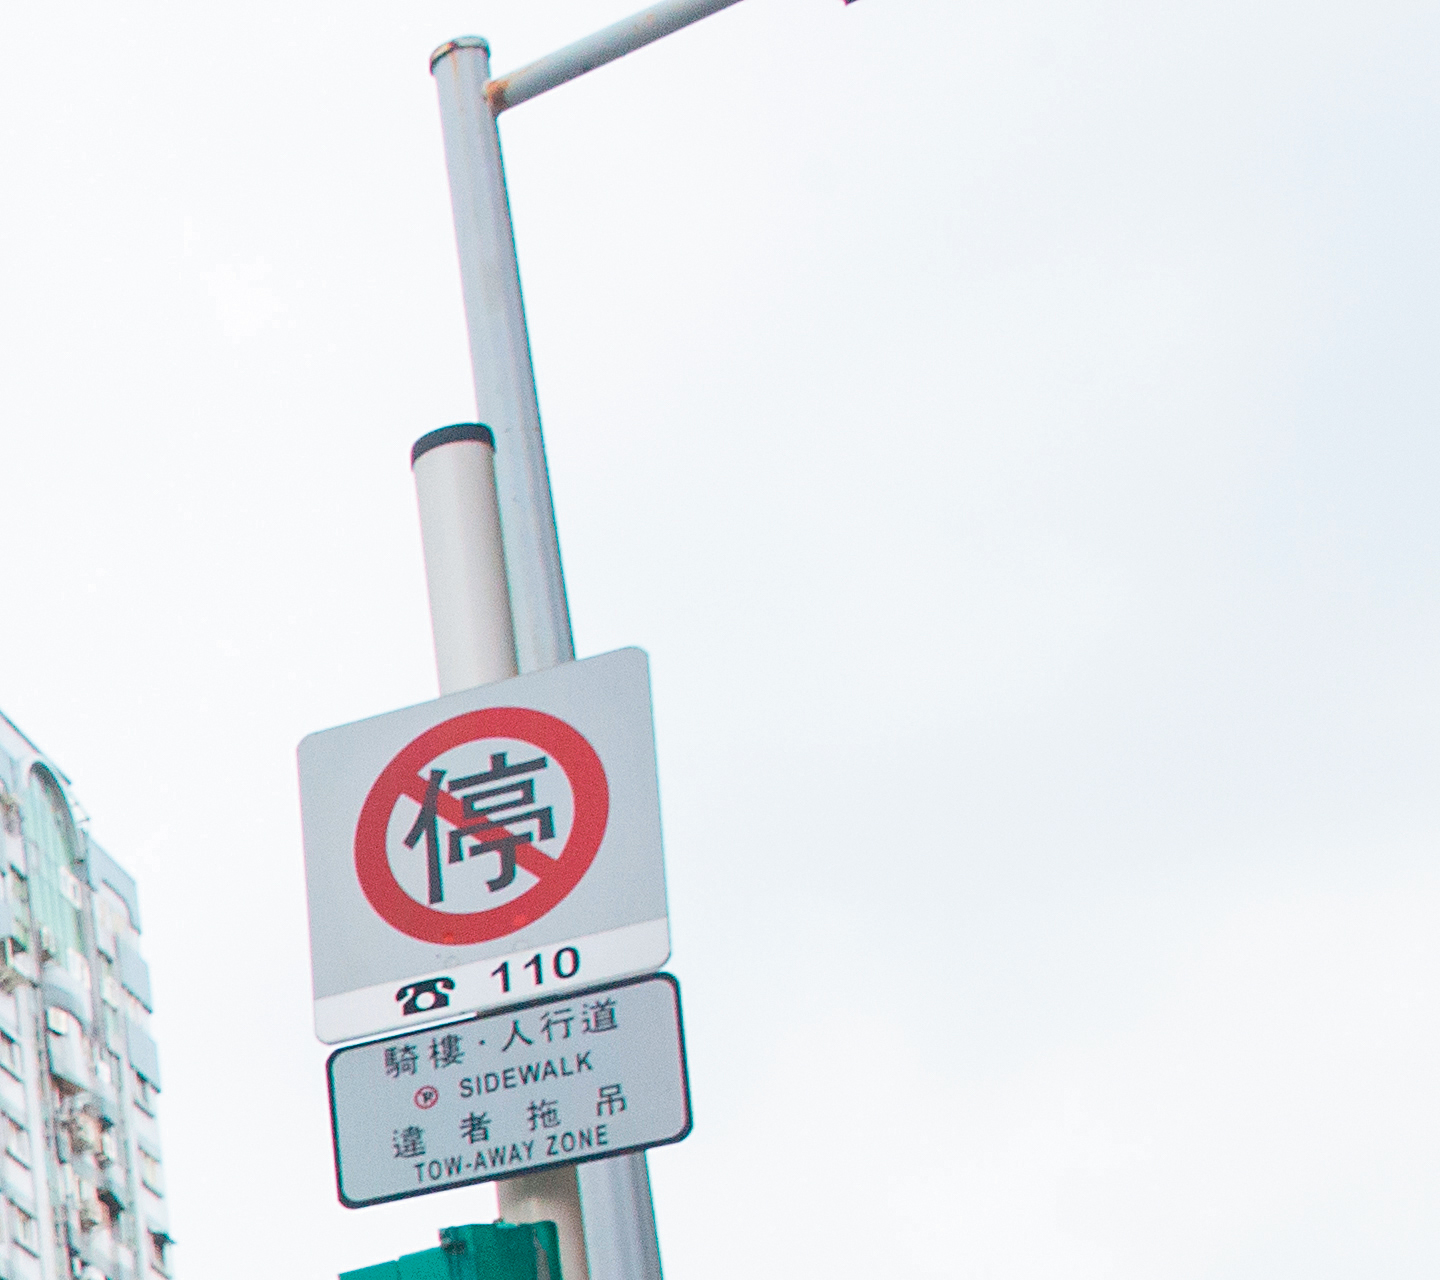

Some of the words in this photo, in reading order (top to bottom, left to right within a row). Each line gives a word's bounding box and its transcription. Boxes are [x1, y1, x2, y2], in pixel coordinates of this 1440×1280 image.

[404, 752, 557, 905] 停
[492, 946, 581, 995] 110
[459, 1052, 594, 1099] SIDEWALK
[393, 1083, 628, 1161] 違者拖吊
[415, 1144, 535, 1184] TOW-AWAY
[546, 1125, 610, 1159] ZONE
